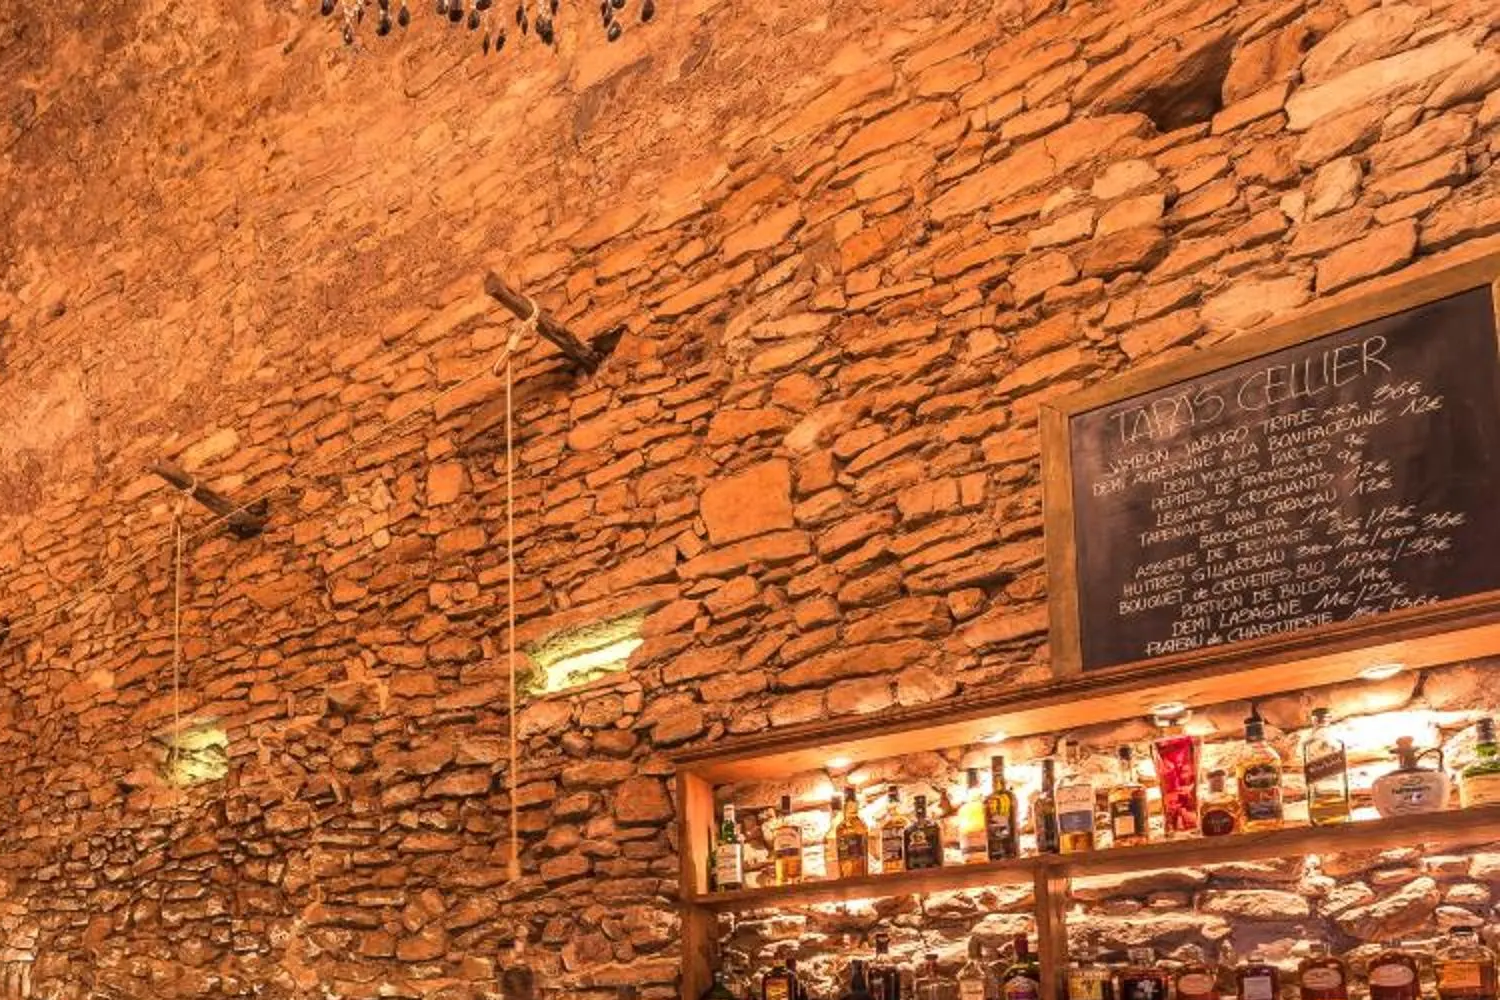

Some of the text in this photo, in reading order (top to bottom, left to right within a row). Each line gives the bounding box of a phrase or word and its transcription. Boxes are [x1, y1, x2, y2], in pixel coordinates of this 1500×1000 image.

[1110, 336, 1392, 443] TAPAS CELLIER
[1092, 478, 1125, 497] DEMI
[1132, 451, 1217, 486] AUBERGINE
[1241, 442, 1259, 458] LA
[1400, 395, 1444, 416] 12€
[1185, 426, 1248, 456] JABUGO
[1259, 408, 1316, 434] TRIPLE
[1163, 476, 1195, 495] DEMI
[1201, 460, 1260, 484] MOULES
[1215, 481, 1235, 495] DE
[1241, 459, 1323, 490] PARMESAN
[1238, 474, 1334, 507] CROQUANTS
[1343, 460, 1391, 480] 12€
[1139, 519, 1214, 548] TAPENADE
[1226, 508, 1256, 525] PAIN
[1350, 477, 1393, 496] 12€
[1206, 547, 1226, 563] DE
[1236, 527, 1313, 553] FROMAGE
[1191, 550, 1285, 582] GILLARDEAU
[1119, 588, 1186, 615] BOUQUET
[1193, 588, 1208, 601] de
[1212, 568, 1293, 595] CREVETTES
[1296, 561, 1325, 579] BIO
[1182, 596, 1243, 617] PORTION
[1253, 588, 1274, 604] DE
[1280, 576, 1341, 598] BULOTS
[1172, 618, 1211, 637] DEMI
[1219, 600, 1302, 628] LASAGNE
[1146, 634, 1203, 656] PLATEAU
